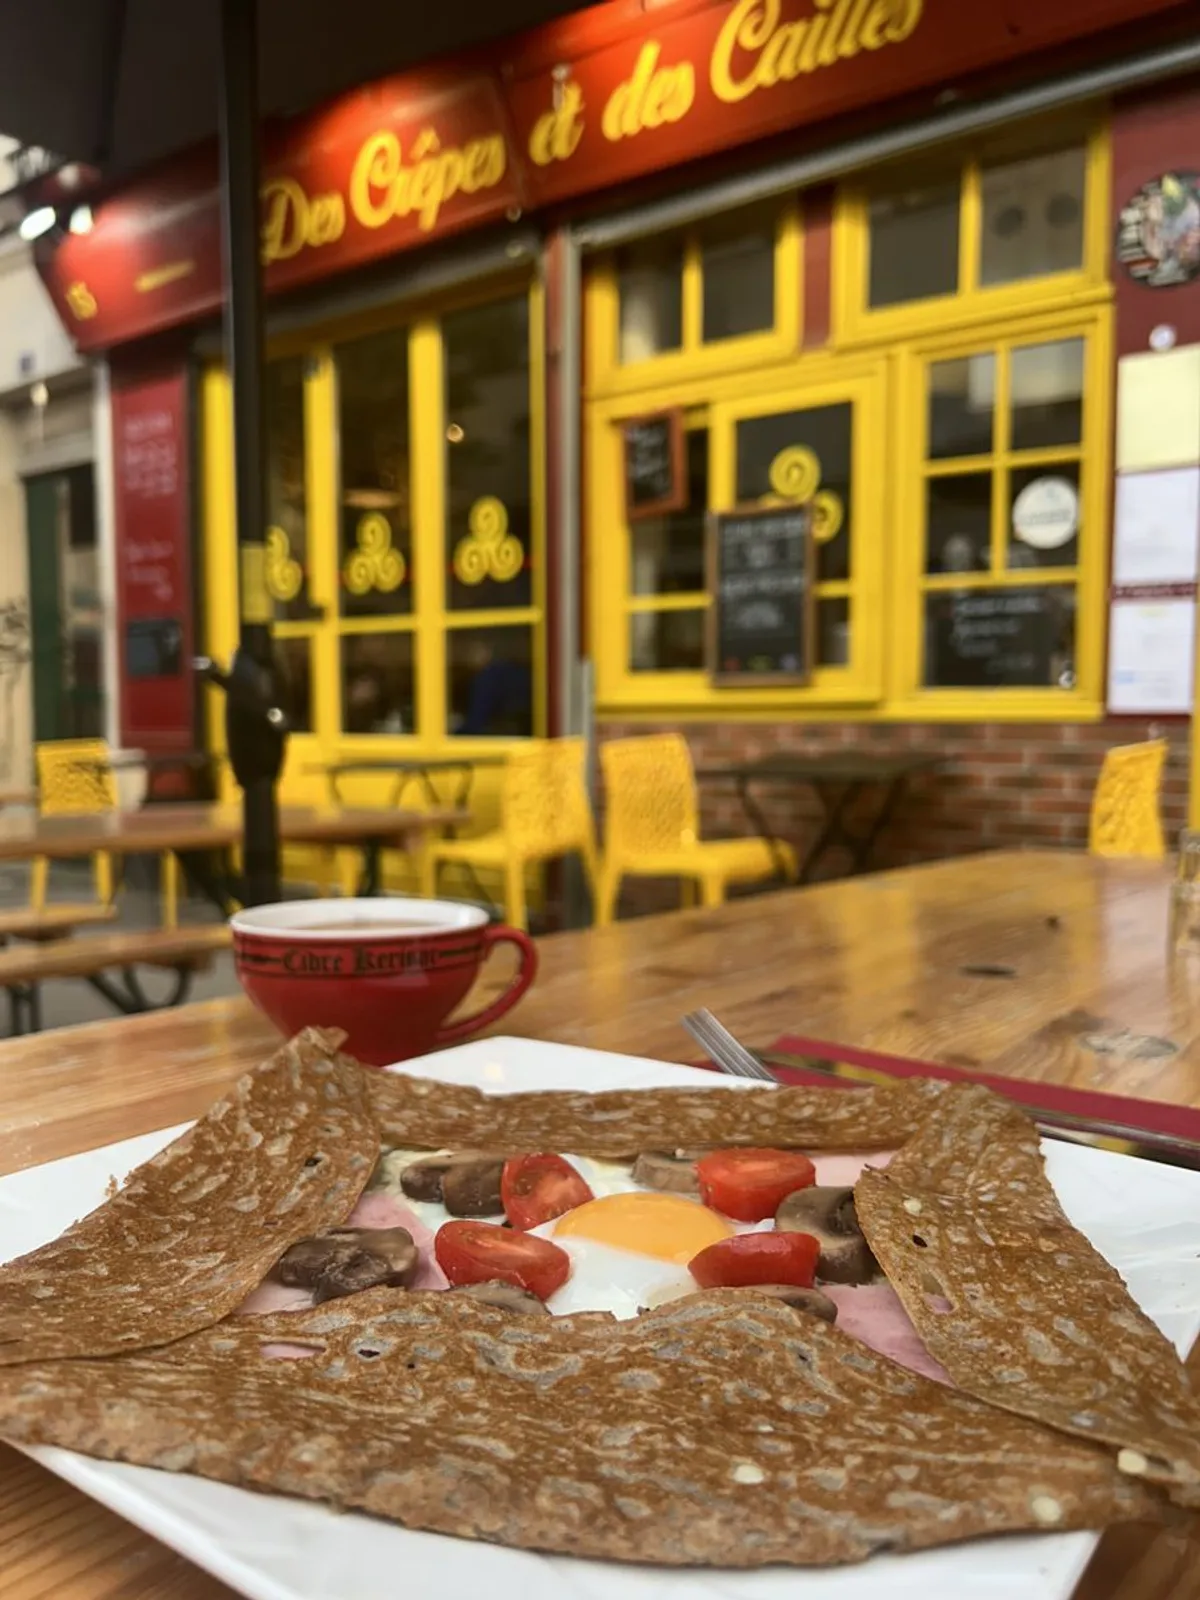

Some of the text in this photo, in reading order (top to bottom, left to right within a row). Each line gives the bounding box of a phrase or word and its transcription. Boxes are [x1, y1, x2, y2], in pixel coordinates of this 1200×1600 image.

[259, 0, 923, 266] Des Crêpes et des Cailles
[283, 947, 344, 976] Cidre
